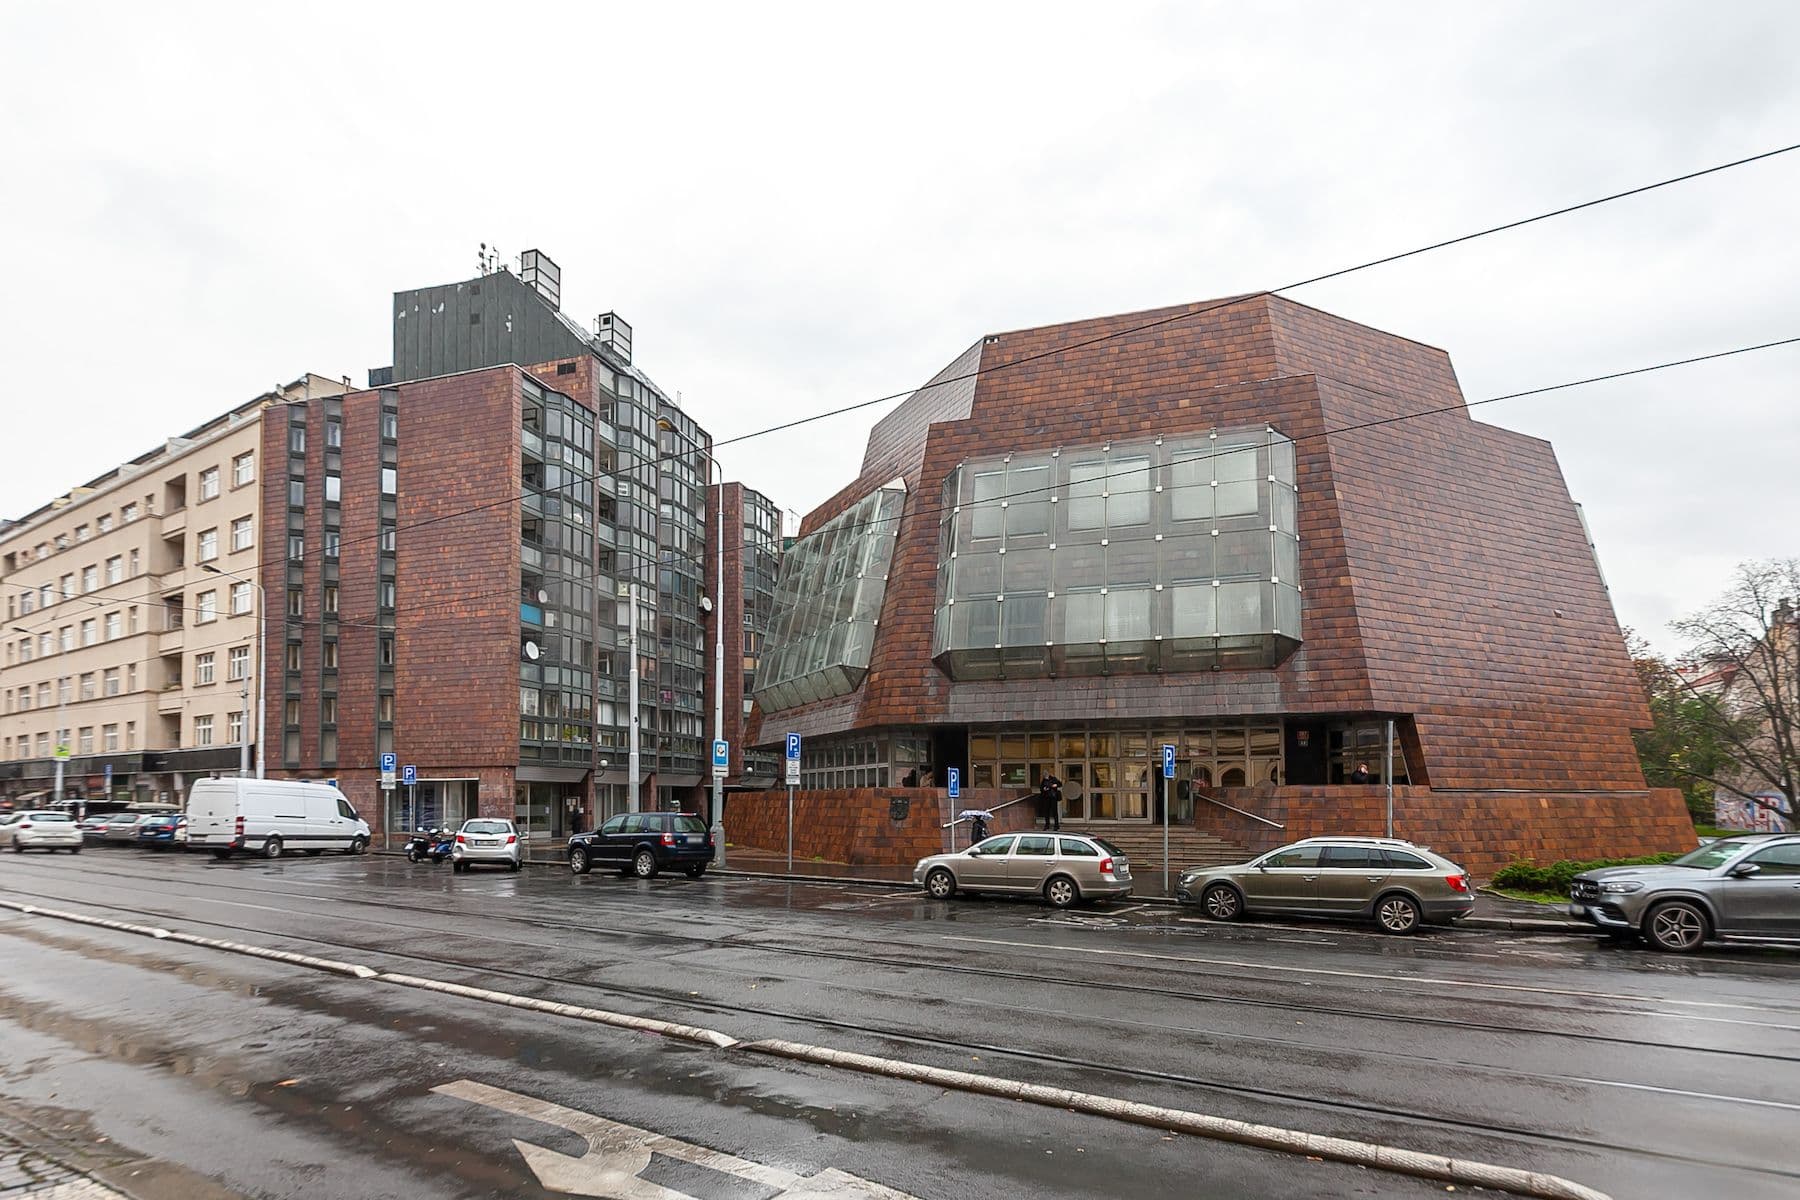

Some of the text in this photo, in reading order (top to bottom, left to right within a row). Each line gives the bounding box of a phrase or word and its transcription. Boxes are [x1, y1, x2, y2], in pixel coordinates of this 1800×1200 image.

[790, 736, 798, 751] P
[384, 755, 393, 766] P
[1165, 749, 1173, 768] P
[405, 767, 414, 779] P
[951, 772, 957, 788] P
